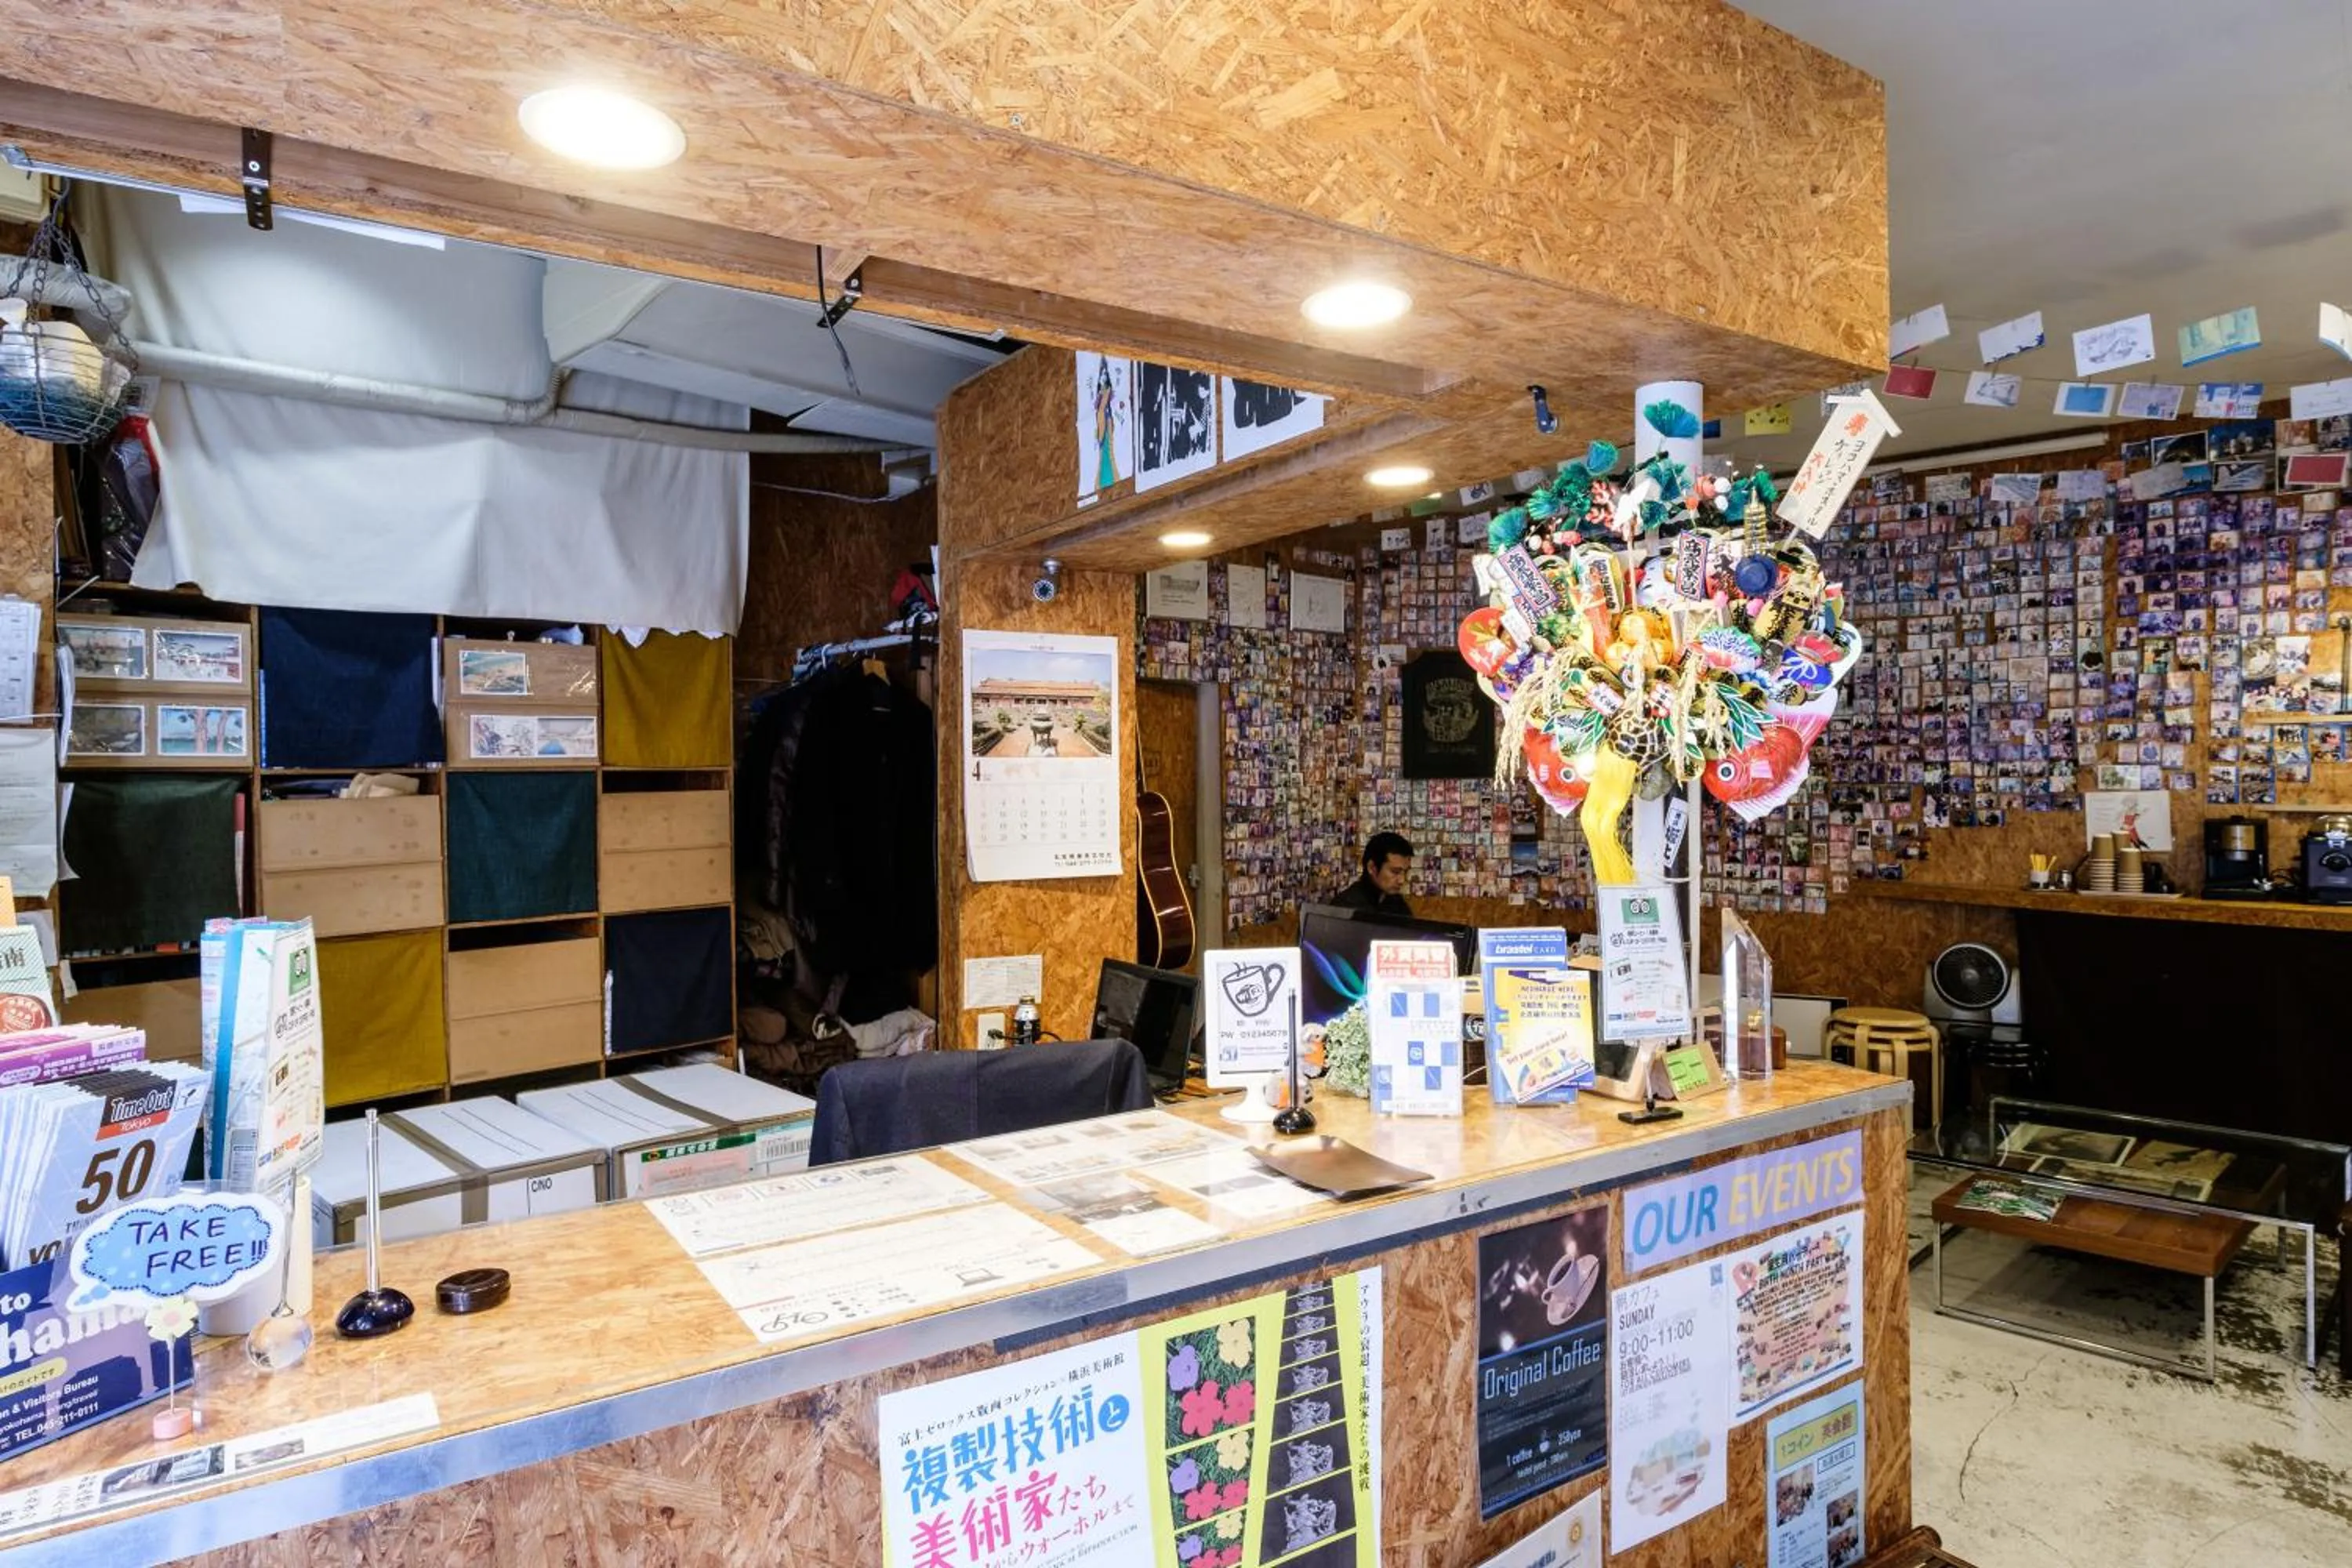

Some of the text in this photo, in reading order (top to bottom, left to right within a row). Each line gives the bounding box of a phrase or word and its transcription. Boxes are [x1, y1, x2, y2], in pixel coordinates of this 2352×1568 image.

[972, 761, 981, 781] 4
[111, 1086, 174, 1123] Time Out
[75, 1138, 156, 1214] 50
[1632, 1183, 1719, 1256] OUR
[1729, 1147, 1857, 1227] EVENTS
[128, 1215, 227, 1246] TAKE
[145, 1240, 265, 1279] FREE!!
[0, 1292, 31, 1316] to
[1619, 1304, 1656, 1330] SUNDAY
[1484, 1350, 1548, 1400] Original
[1552, 1338, 1602, 1377] Coffee
[12, 1403, 20, 1414] &
[23, 1389, 62, 1410] Visitors
[64, 1375, 98, 1395] Bureau
[901, 1384, 1131, 1515] 複製技術と
[909, 1470, 1107, 1568] 美術家たち
